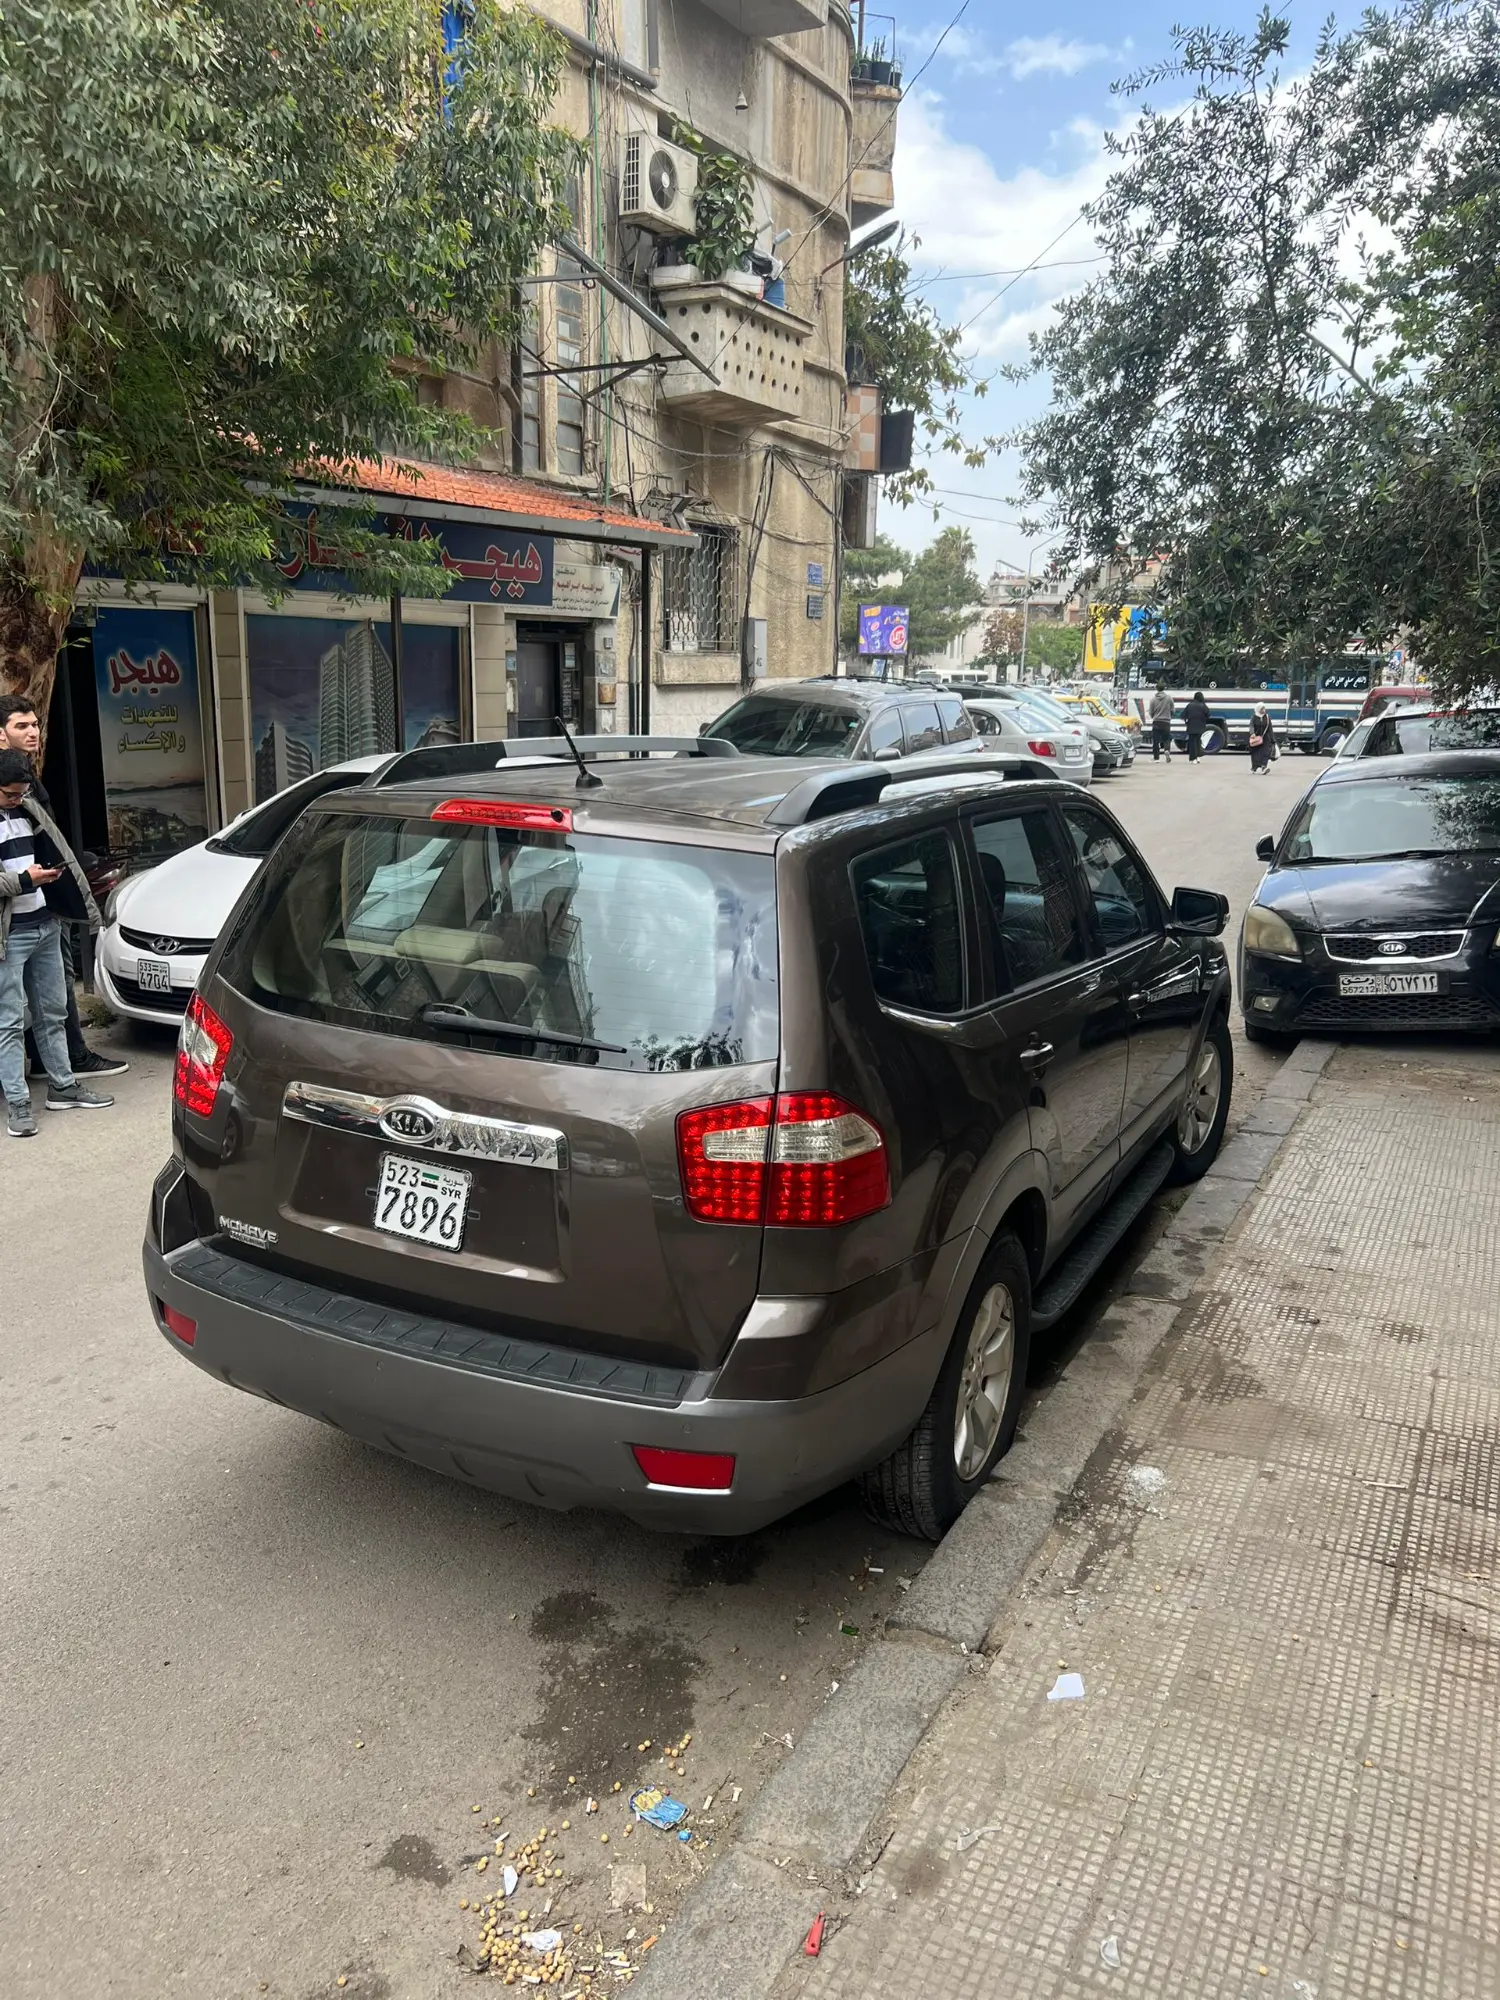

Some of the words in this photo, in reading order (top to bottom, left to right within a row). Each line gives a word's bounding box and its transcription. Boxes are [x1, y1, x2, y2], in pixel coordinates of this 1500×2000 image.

[110, 650, 180, 694] هيجر
[121, 704, 179, 728] للتعهدات
[1383, 944, 1403, 952] KIA
[140, 962, 152, 972] 533
[140, 972, 168, 990] 4704
[1341, 976, 1375, 986] دمشق
[1389, 975, 1436, 992] ٥٦٧٢١٢
[1342, 986, 1375, 994] 567212
[390, 1111, 426, 1135] KIA
[386, 1160, 420, 1188] 523
[442, 1174, 464, 1187] سورية
[440, 1187, 462, 1200] SYR
[381, 1185, 459, 1240] 7896
[219, 1215, 279, 1244] MOHAVE
